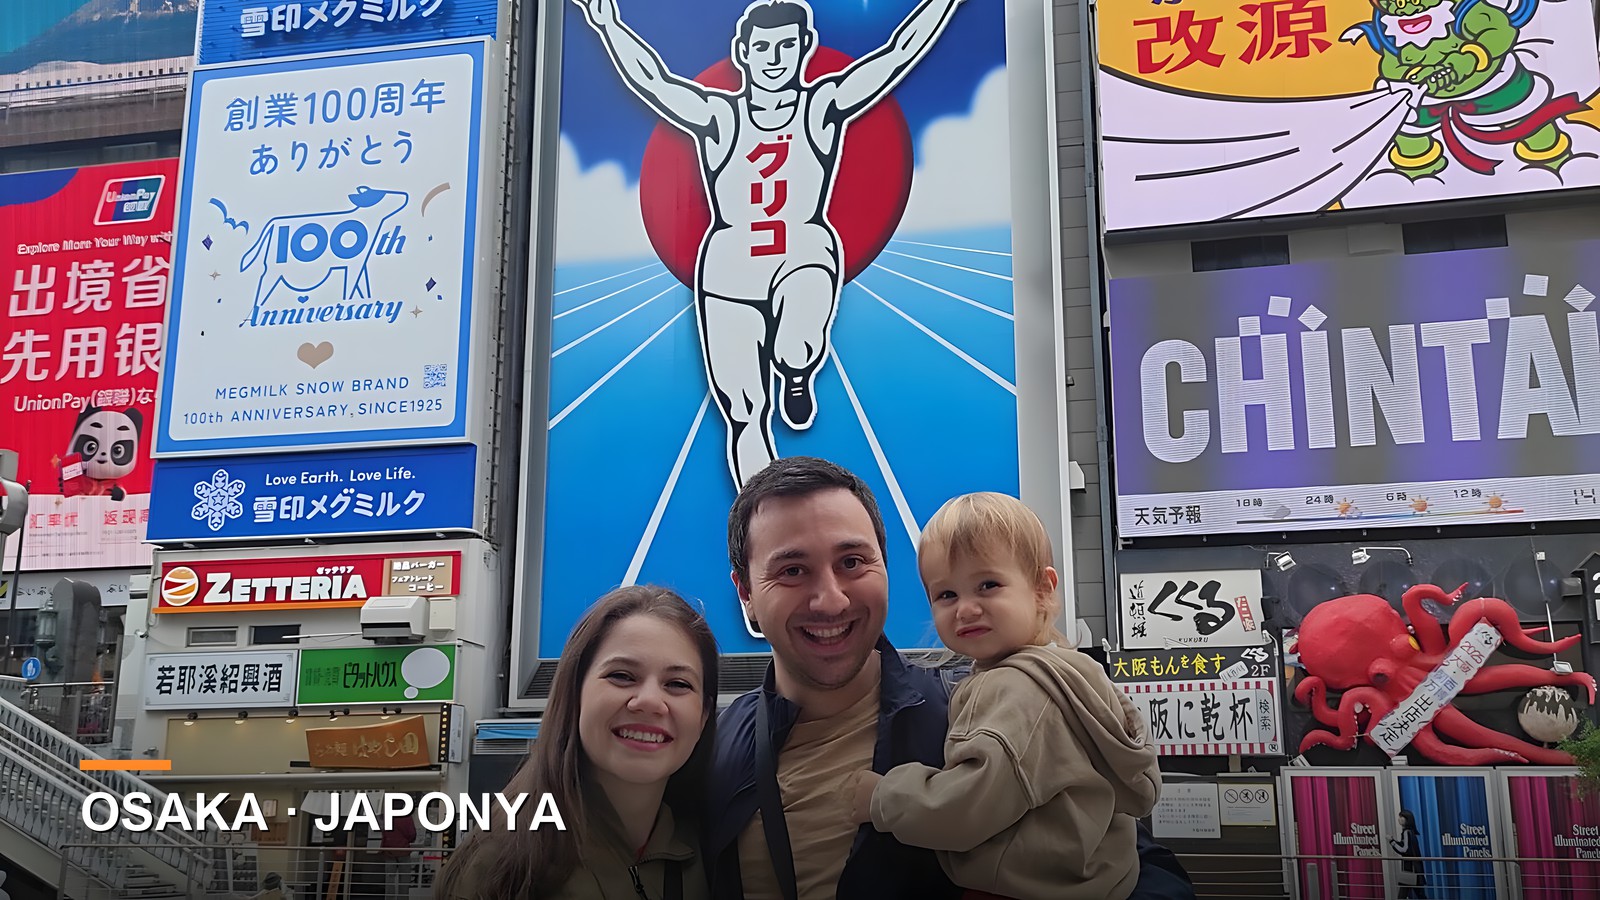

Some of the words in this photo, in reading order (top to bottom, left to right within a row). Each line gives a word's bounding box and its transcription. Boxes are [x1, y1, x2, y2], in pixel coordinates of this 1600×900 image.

[1133, 0, 1333, 74] 改源
[223, 78, 446, 132] 創業100周年
[249, 130, 413, 175] ありがとう
[746, 134, 793, 257] グリコ
[94, 237, 121, 248] Your
[123, 234, 148, 247] Way
[276, 219, 406, 264] 100th
[8, 255, 170, 317] 出境省
[239, 299, 403, 328] Anniversary
[215, 384, 288, 400] MEGMILK
[295, 381, 345, 396] SNOW
[351, 377, 409, 392] BRAND
[183, 412, 223, 425] 100th
[265, 473, 297, 486] Love
[300, 470, 343, 484] Earth.
[350, 469, 382, 482] Love
[385, 466, 415, 480] Life.
[253, 488, 425, 523] 雪印メグミルク
[1134, 505, 1202, 526] 天気予報
[203, 572, 367, 604] ZETTERIA
[1147, 580, 1236, 635] くくる
[1113, 653, 1226, 677] 大阪もんを食す
[1251, 664, 1271, 677] 2F
[1129, 693, 1253, 742] 阪に乾杯
[1380, 694, 1433, 746] 出店決定
[1350, 822, 1375, 834] Street
[1460, 822, 1486, 835] Street
[1572, 823, 1599, 836] Street
